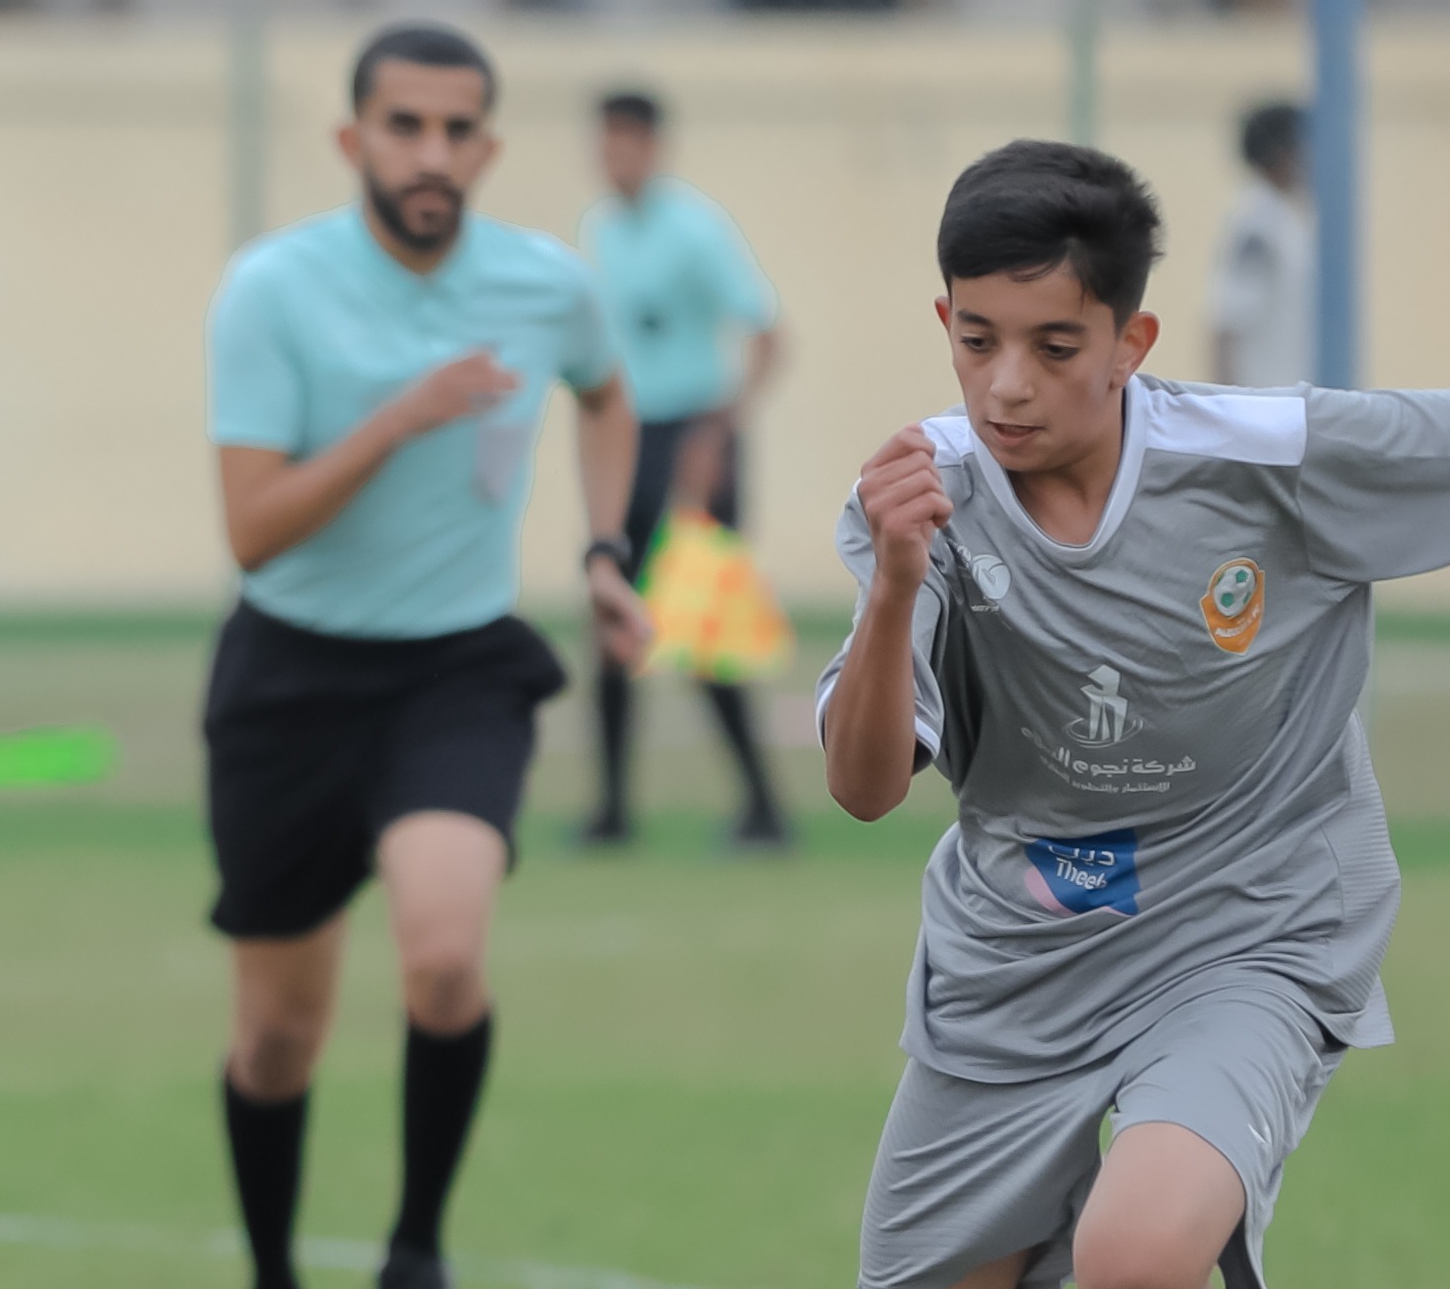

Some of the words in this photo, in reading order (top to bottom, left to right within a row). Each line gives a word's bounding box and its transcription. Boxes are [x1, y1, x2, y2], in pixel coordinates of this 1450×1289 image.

[1072, 758, 1128, 778] نجوم
[1131, 755, 1197, 777] شركة
[1056, 857, 1108, 890] Theeb
